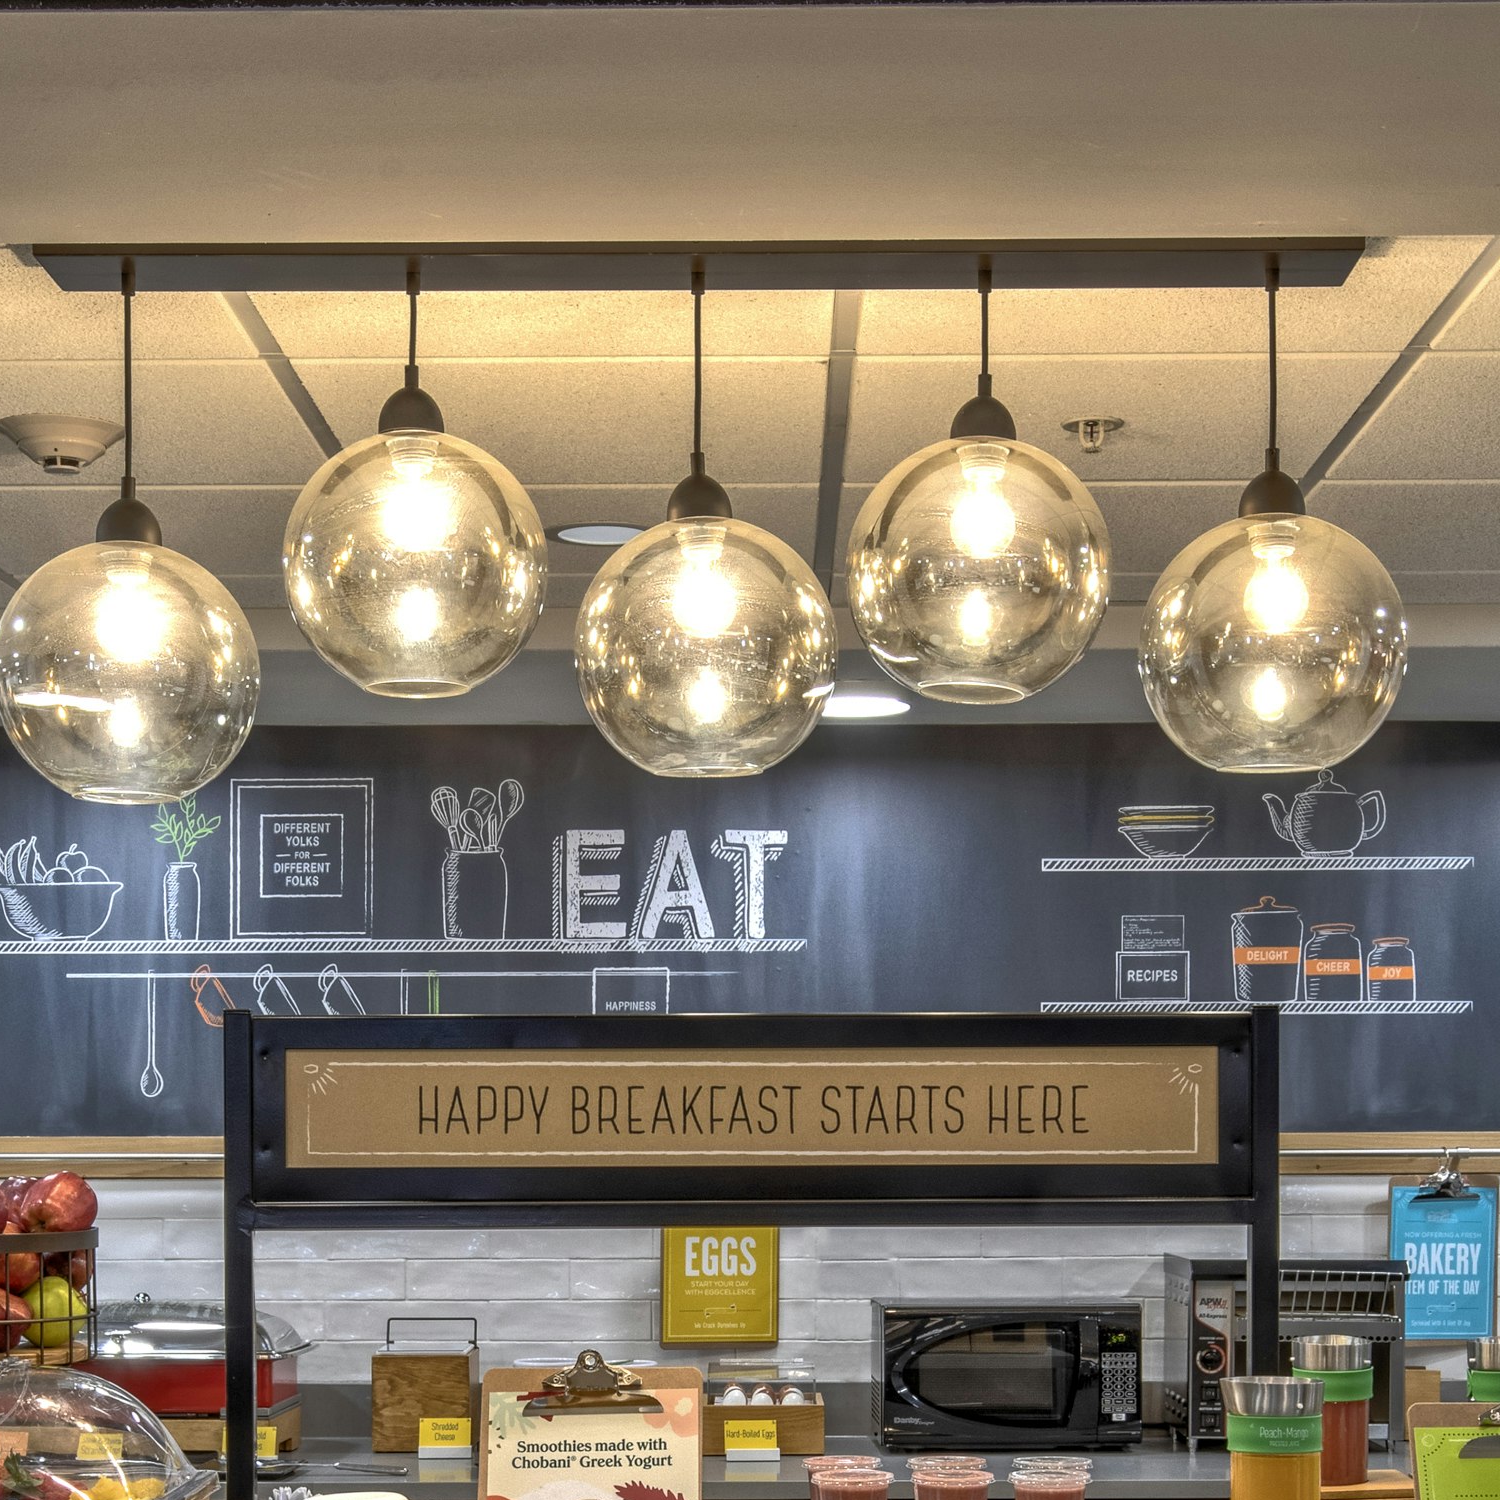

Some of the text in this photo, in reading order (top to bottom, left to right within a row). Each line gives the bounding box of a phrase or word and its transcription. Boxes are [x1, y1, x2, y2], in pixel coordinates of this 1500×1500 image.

[274, 823, 331, 834] DIFFERENT
[285, 836, 320, 847] YOLKS
[294, 851, 310, 859] FOR
[274, 862, 331, 873] DIFFERENT
[285, 876, 319, 887] FOLKS
[566, 829, 788, 939] EAT
[1246, 950, 1288, 961] DELIGHT
[1316, 962, 1350, 972] CHEER
[1127, 969, 1178, 982] RECIPES
[1382, 968, 1402, 978] JOY
[605, 1001, 657, 1011] HAPPINESS
[418, 1085, 1090, 1135] HAPPY BREAKFAST STARTS HERE
[685, 1236, 757, 1276] EGGS
[1404, 1242, 1482, 1275] BAKERY
[1405, 1280, 1480, 1295] ITEM OF THE DAY
[431, 1422, 459, 1431] Shredded
[434, 1432, 455, 1441] Cheese
[726, 1429, 775, 1440] Hard-Boiled Eggs
[517, 1438, 668, 1453] Smoothies made with
[580, 1455, 623, 1468] Greek
[626, 1455, 673, 1470] Yogurt
